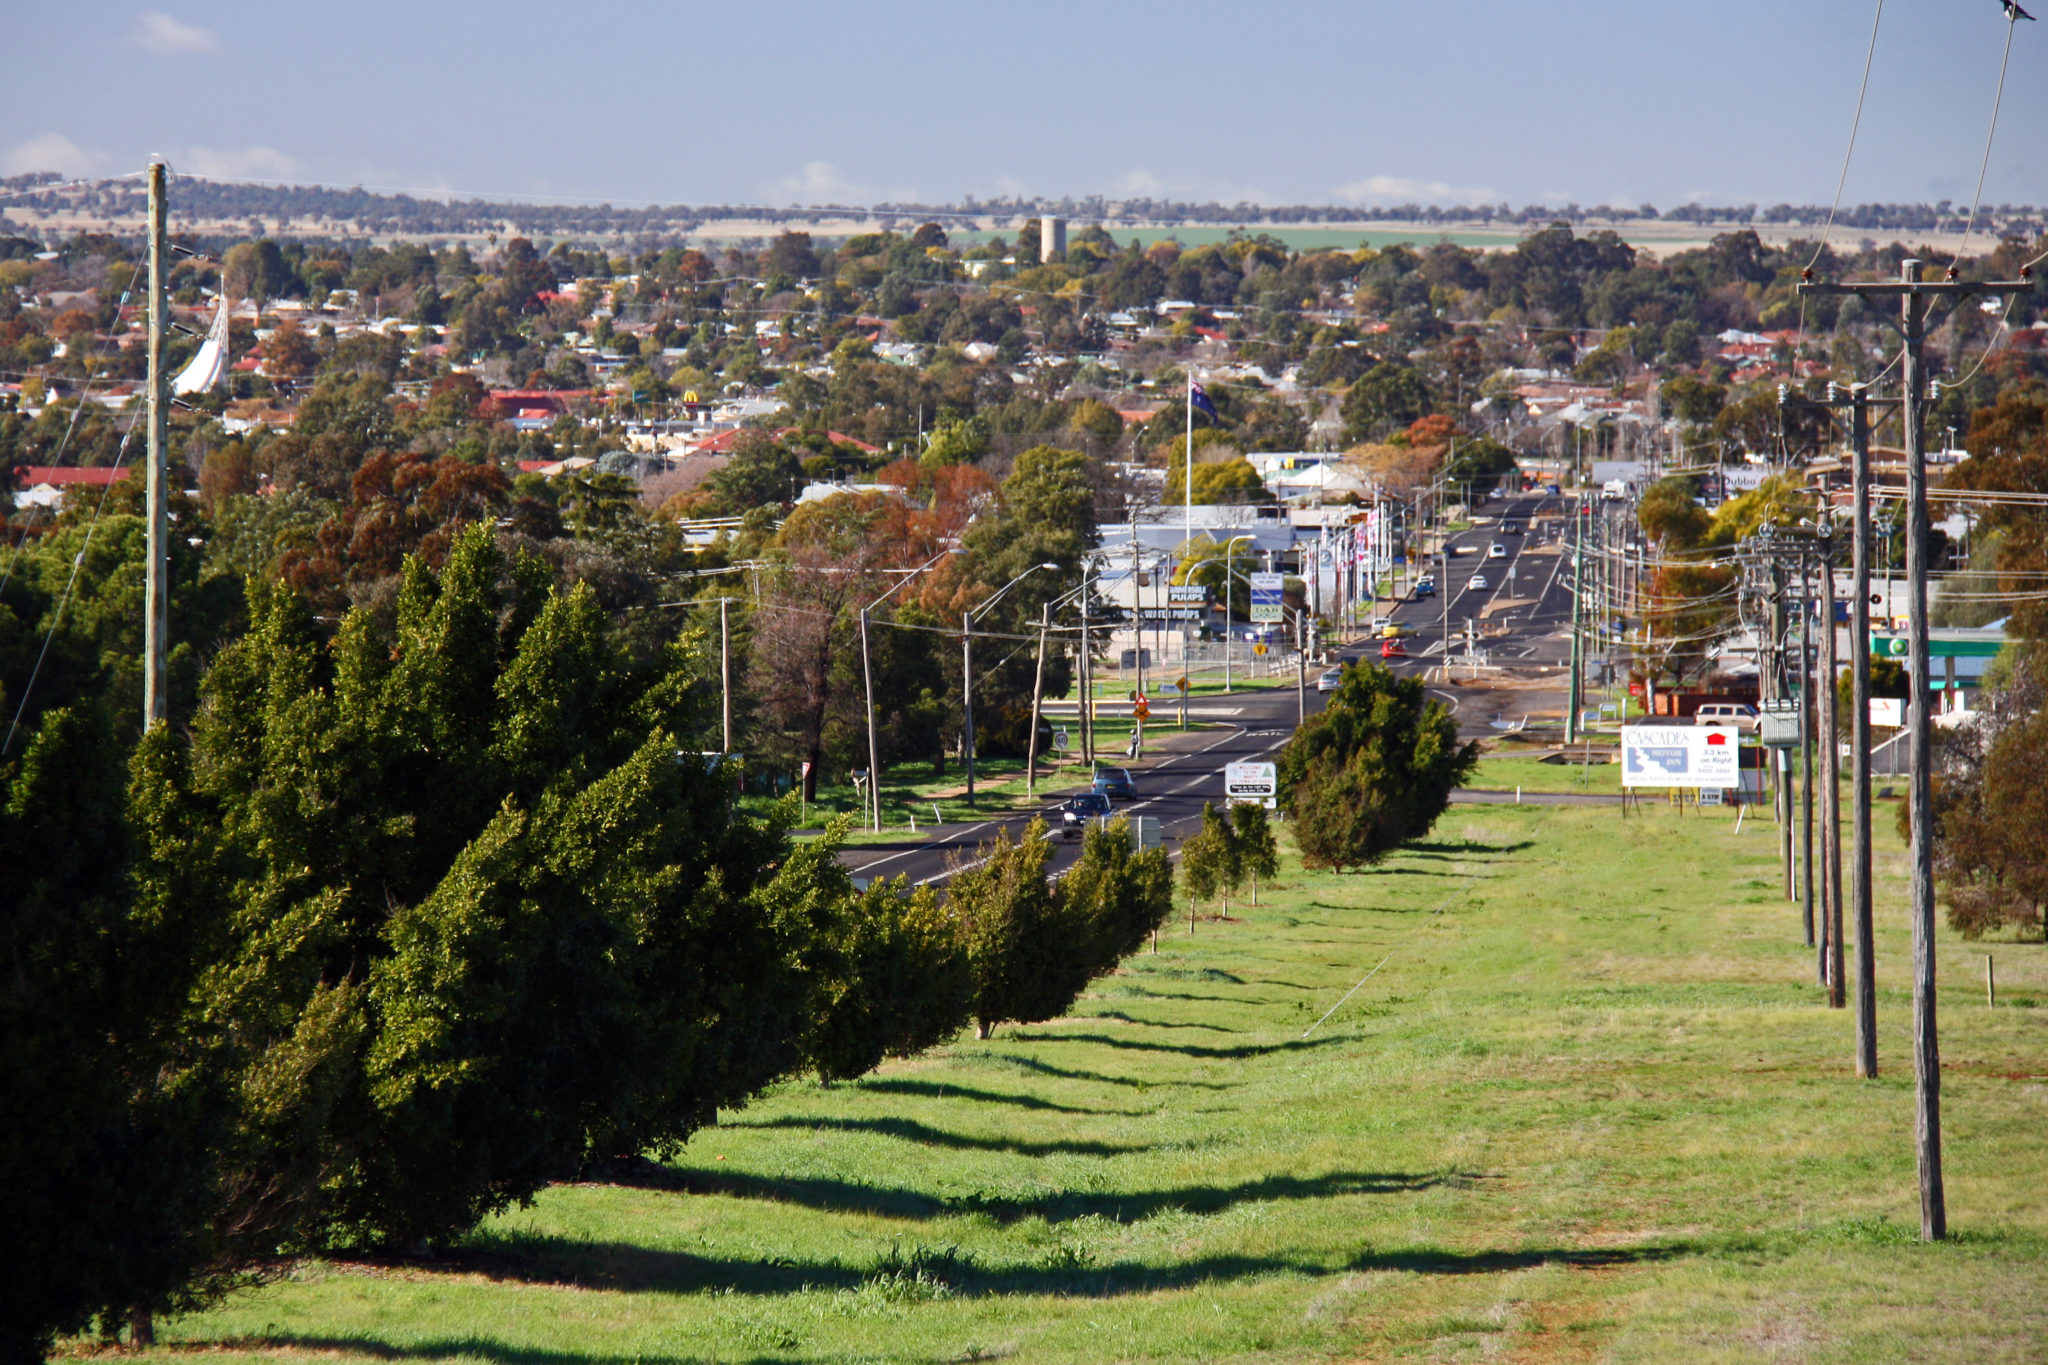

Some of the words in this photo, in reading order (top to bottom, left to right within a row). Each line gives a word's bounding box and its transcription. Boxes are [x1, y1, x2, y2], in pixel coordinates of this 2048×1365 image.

[1171, 593, 1204, 601] PUMPS
[1173, 609, 1200, 619] PUMPS
[1626, 728, 1690, 745] CASCADES
[1651, 749, 1682, 757] MOTOR
[1666, 758, 1682, 766] INN
[1712, 757, 1732, 765] Right
